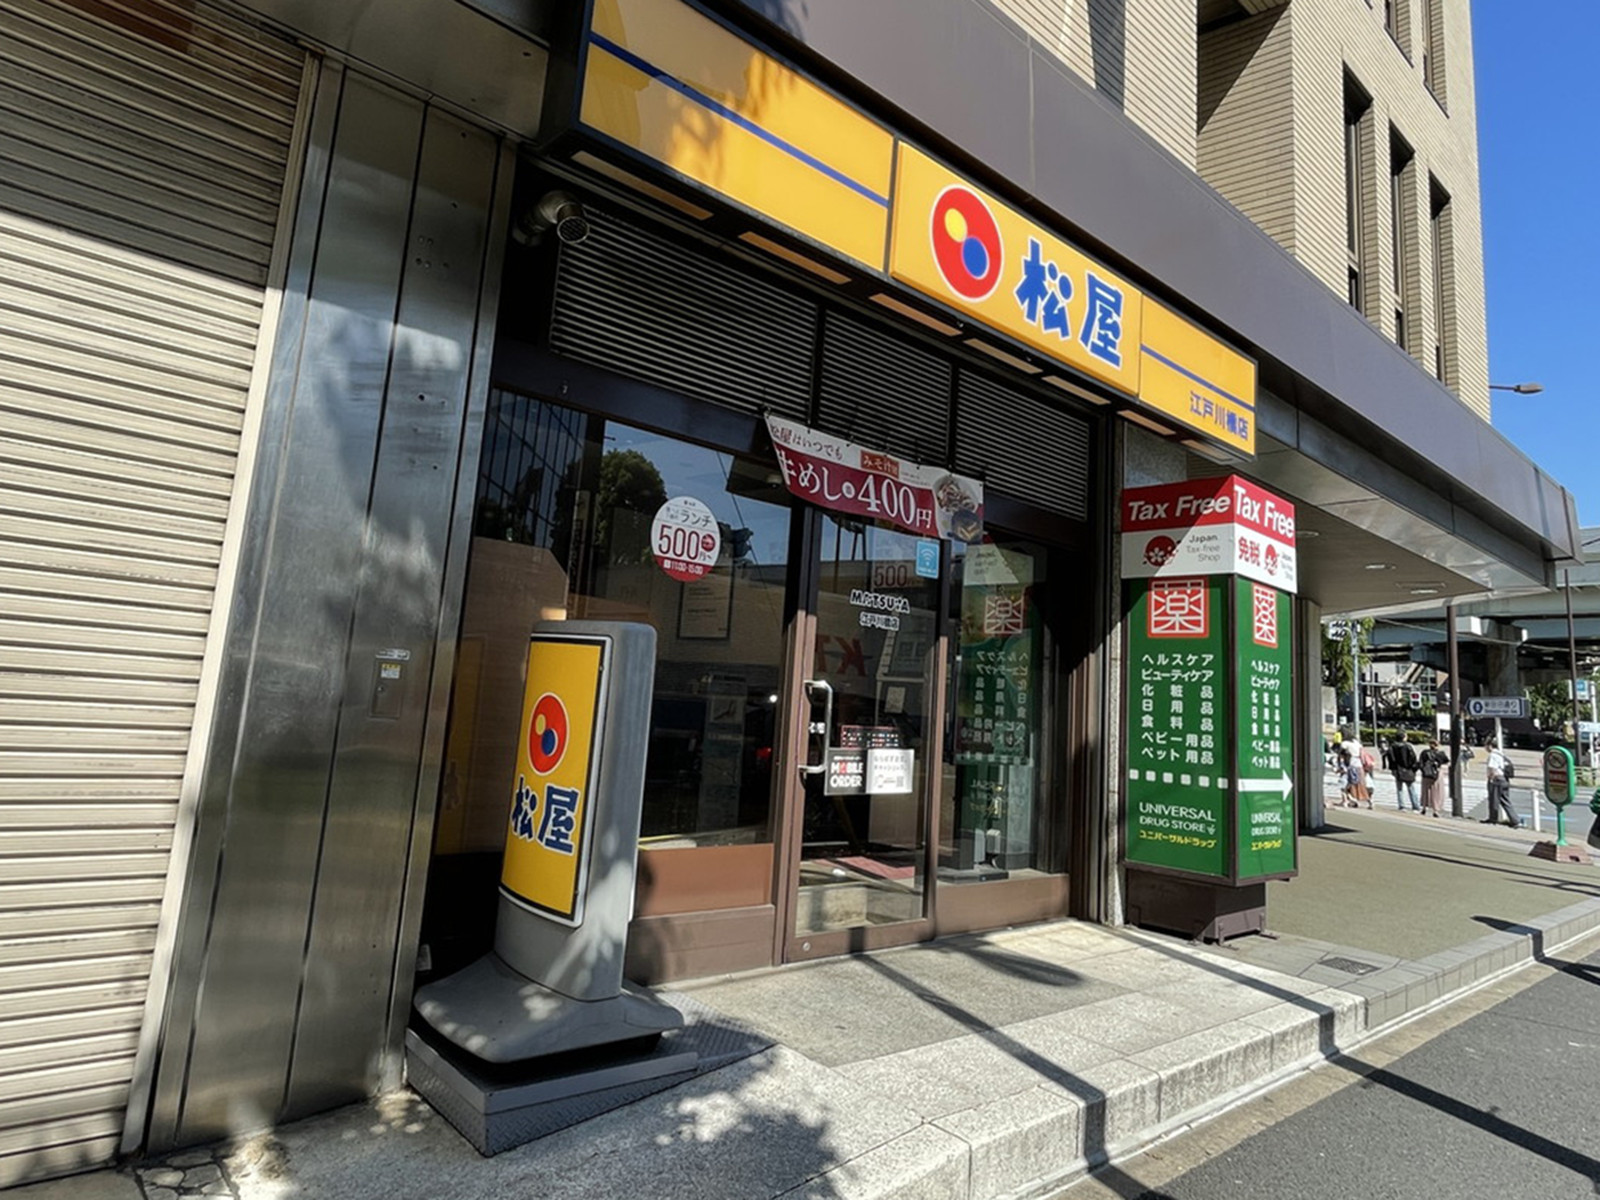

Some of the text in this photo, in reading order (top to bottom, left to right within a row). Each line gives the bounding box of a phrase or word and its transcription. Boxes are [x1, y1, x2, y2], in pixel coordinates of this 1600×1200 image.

[1014, 237, 1123, 370] 松屋
[1128, 495, 1231, 521] Tax Free
[1234, 484, 1295, 538] Tax Free
[658, 524, 700, 560] 500
[1189, 534, 1218, 544] Japan
[1238, 536, 1260, 566] 免税
[1142, 653, 1214, 666] ヘルスケア
[1142, 668, 1214, 682] ビューティケア
[1142, 683, 1214, 699] 化粧品
[1142, 699, 1214, 715] 日用品
[1142, 714, 1214, 731] 食料品
[1142, 732, 1214, 748] ベビー用品
[511, 773, 580, 856] 松屋
[1139, 802, 1217, 822] UNIVERSAL
[1139, 815, 1206, 833] DRUG STORE
